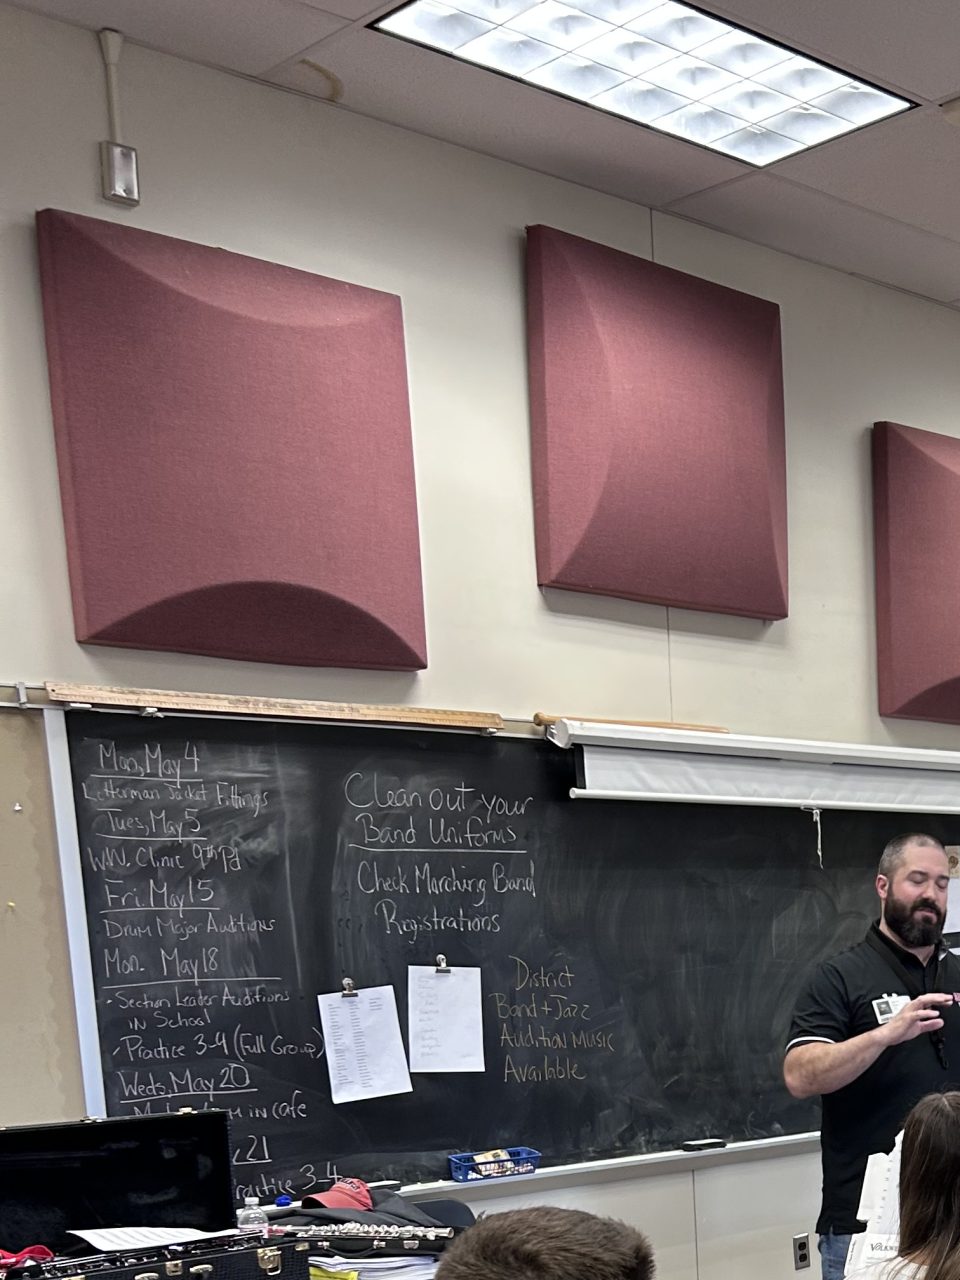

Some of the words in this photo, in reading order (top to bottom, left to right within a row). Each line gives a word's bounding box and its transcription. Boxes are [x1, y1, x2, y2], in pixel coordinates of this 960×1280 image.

[145, 743, 181, 788] May
[184, 741, 200, 773] 4
[345, 772, 422, 808] Clean
[429, 781, 476, 812] out
[480, 793, 534, 823] your
[149, 809, 183, 843] May
[184, 808, 201, 832] 5
[355, 813, 416, 844] Band
[429, 816, 517, 847] Uniforms
[136, 847, 185, 868] Clinic
[149, 878, 185, 918] May
[188, 876, 215, 903] 15
[357, 860, 410, 894] Check
[415, 862, 487, 907] Marching
[492, 859, 536, 898] Band
[156, 916, 203, 940] Major
[207, 912, 275, 934] Auditions
[374, 898, 500, 944] Registrations
[104, 948, 145, 978] Mon.
[160, 947, 199, 985] May
[202, 947, 219, 973] 18
[508, 954, 575, 991] District
[115, 991, 171, 1009] Section
[175, 986, 219, 1007] Leader
[222, 983, 289, 1007] Auditions
[488, 992, 537, 1019] Band
[550, 994, 591, 1020] Jazz
[154, 1009, 211, 1028] School
[120, 1034, 185, 1061] Practice
[169, 1068, 215, 1102] May
[219, 1063, 250, 1088] 20
[504, 1054, 586, 1083] Available
[248, 1135, 269, 1161] 21
[234, 1174, 297, 1200] ractice
